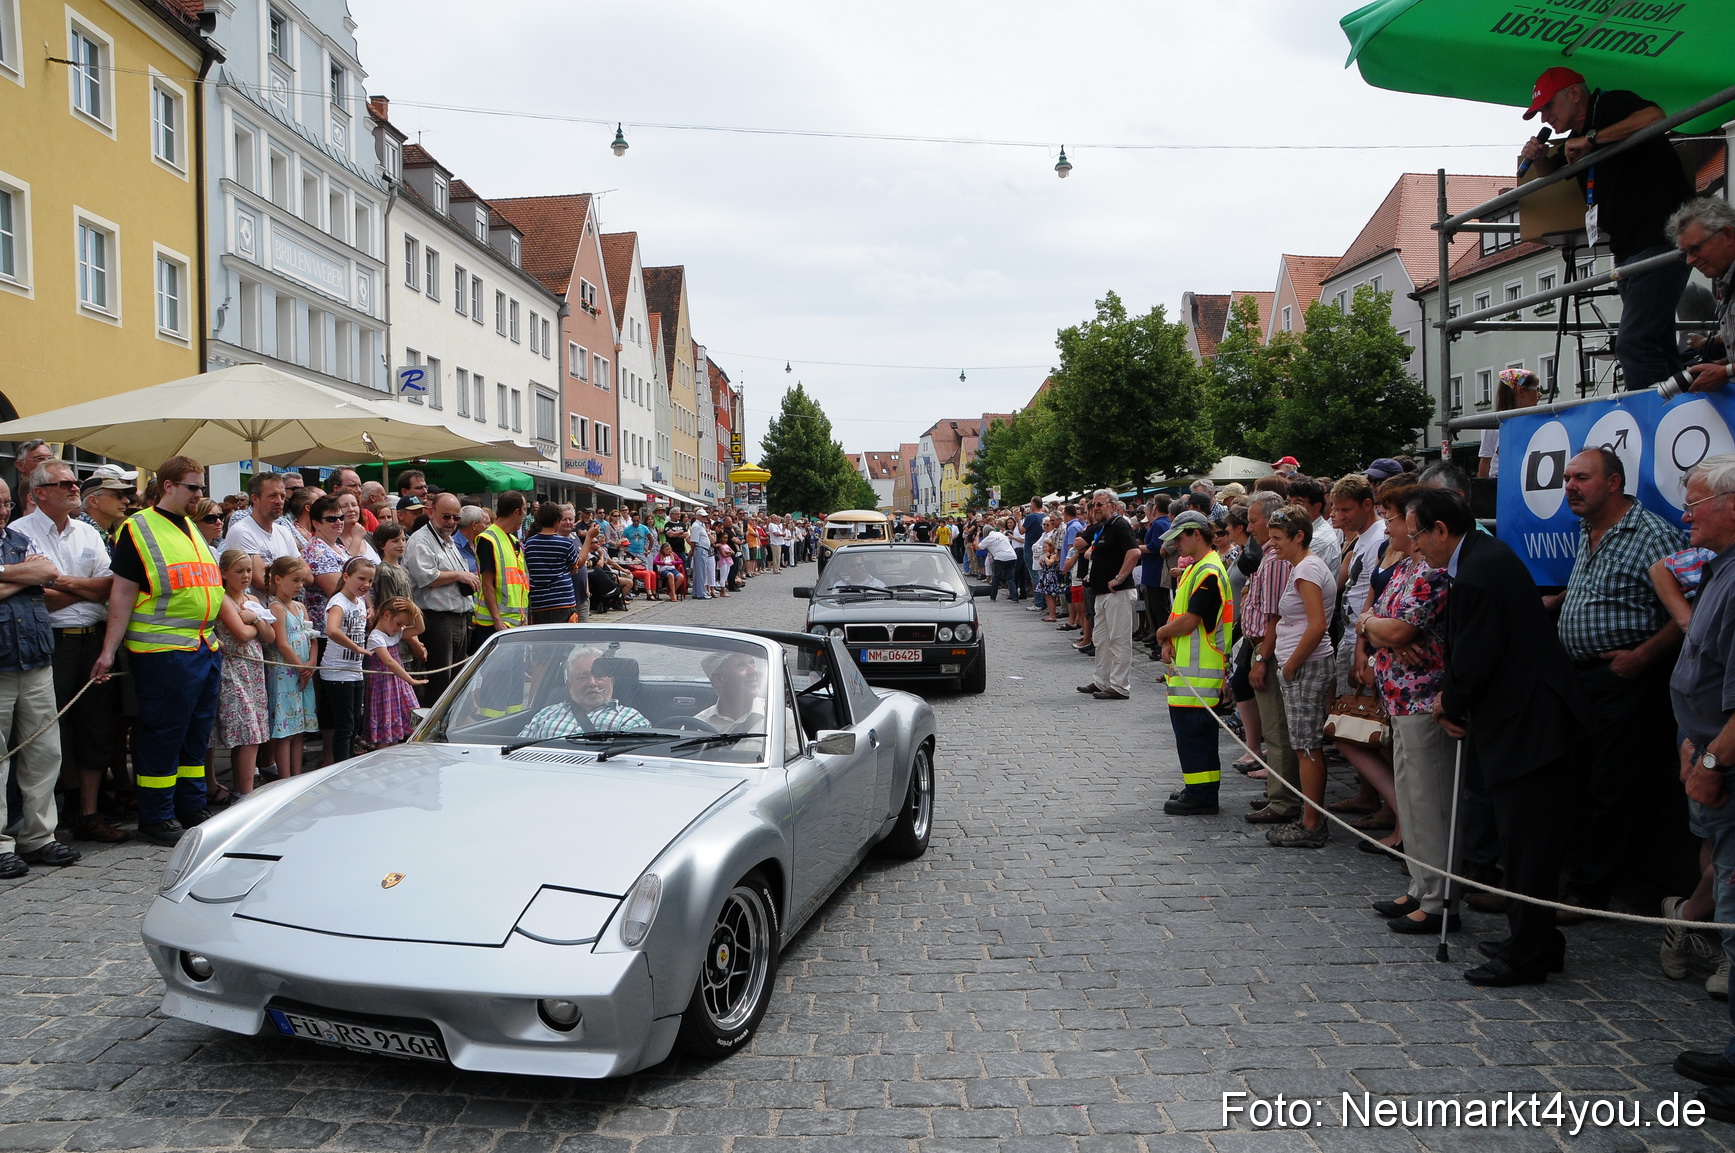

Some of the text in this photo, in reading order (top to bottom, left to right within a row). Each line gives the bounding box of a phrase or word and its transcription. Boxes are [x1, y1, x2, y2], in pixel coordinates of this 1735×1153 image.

[276, 240, 344, 290] BRILLEN WEBER
[731, 433, 742, 469] HOT
[168, 563, 219, 586] THW
[868, 650, 920, 660] NM 06425
[284, 1014, 443, 1058] FÜ RS 916H
